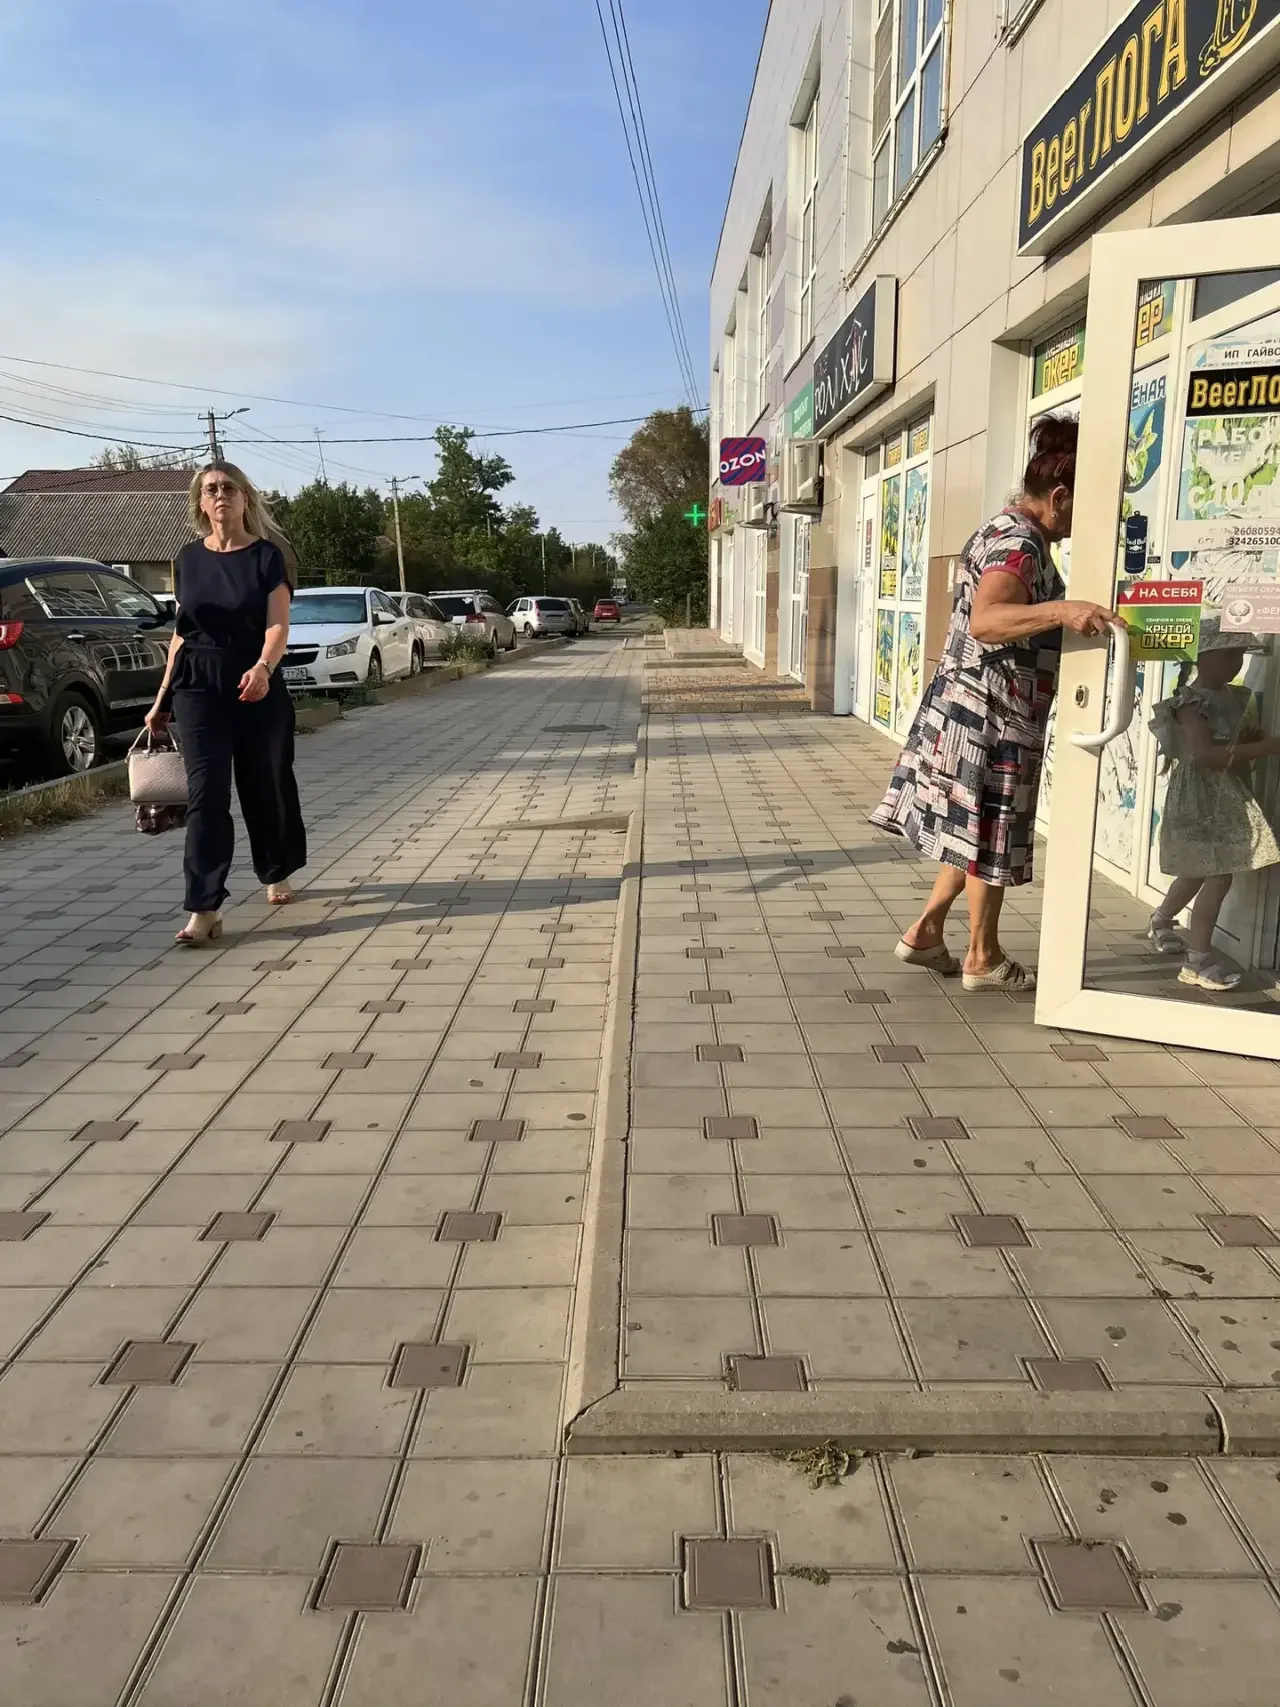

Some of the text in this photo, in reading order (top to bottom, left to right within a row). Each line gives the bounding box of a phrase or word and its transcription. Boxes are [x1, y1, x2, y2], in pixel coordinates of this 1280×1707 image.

[1224, 349, 1240, 359] ИП
[720, 449, 766, 473] OZON
[1139, 587, 1198, 598] НА СЕБЯ
[1145, 623, 1191, 633] КРУТОЙ
